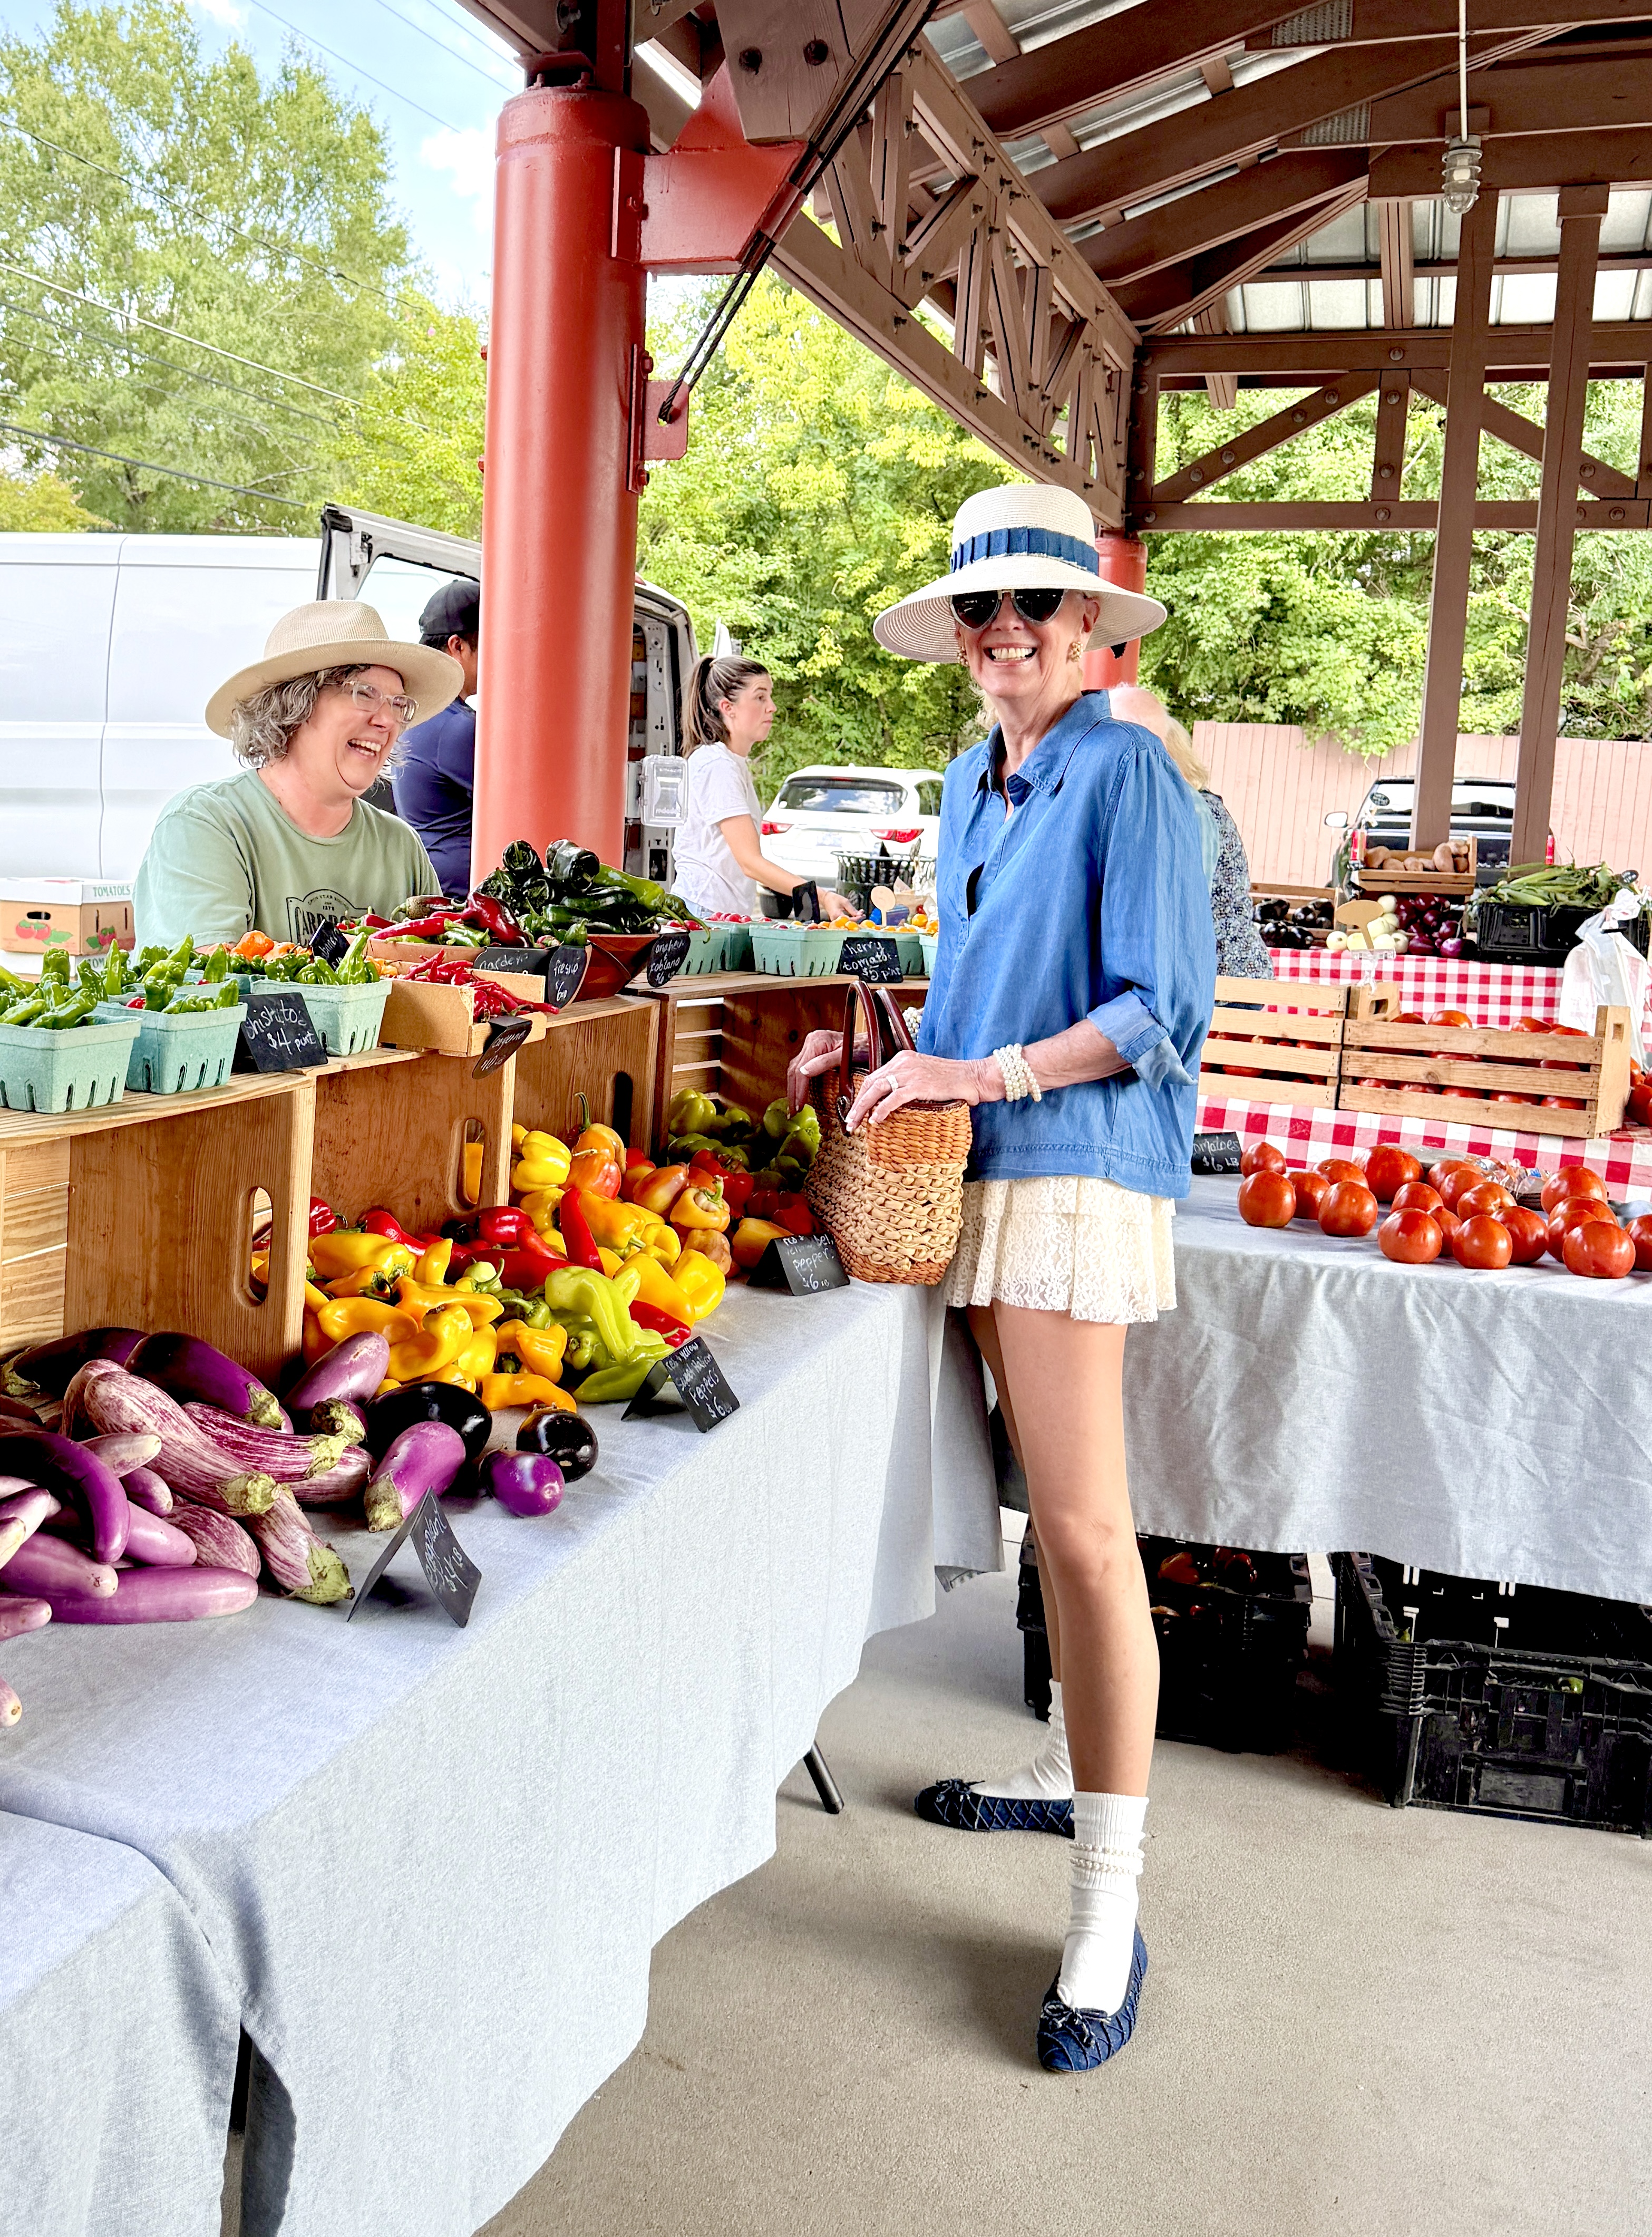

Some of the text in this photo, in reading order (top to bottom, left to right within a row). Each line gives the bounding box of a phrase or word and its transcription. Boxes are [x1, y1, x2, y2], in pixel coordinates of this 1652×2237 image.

[93, 885, 131, 897] TOMATOES
[862, 965, 879, 981] $5
[267, 1028, 316, 1055] $4 pint
[1193, 1136, 1240, 1156] omatoes
[1202, 1156, 1239, 1171] $6 LB
[793, 1247, 834, 1276] pepper
[802, 1273, 819, 1290] $6
[706, 1396, 726, 1419] $6
